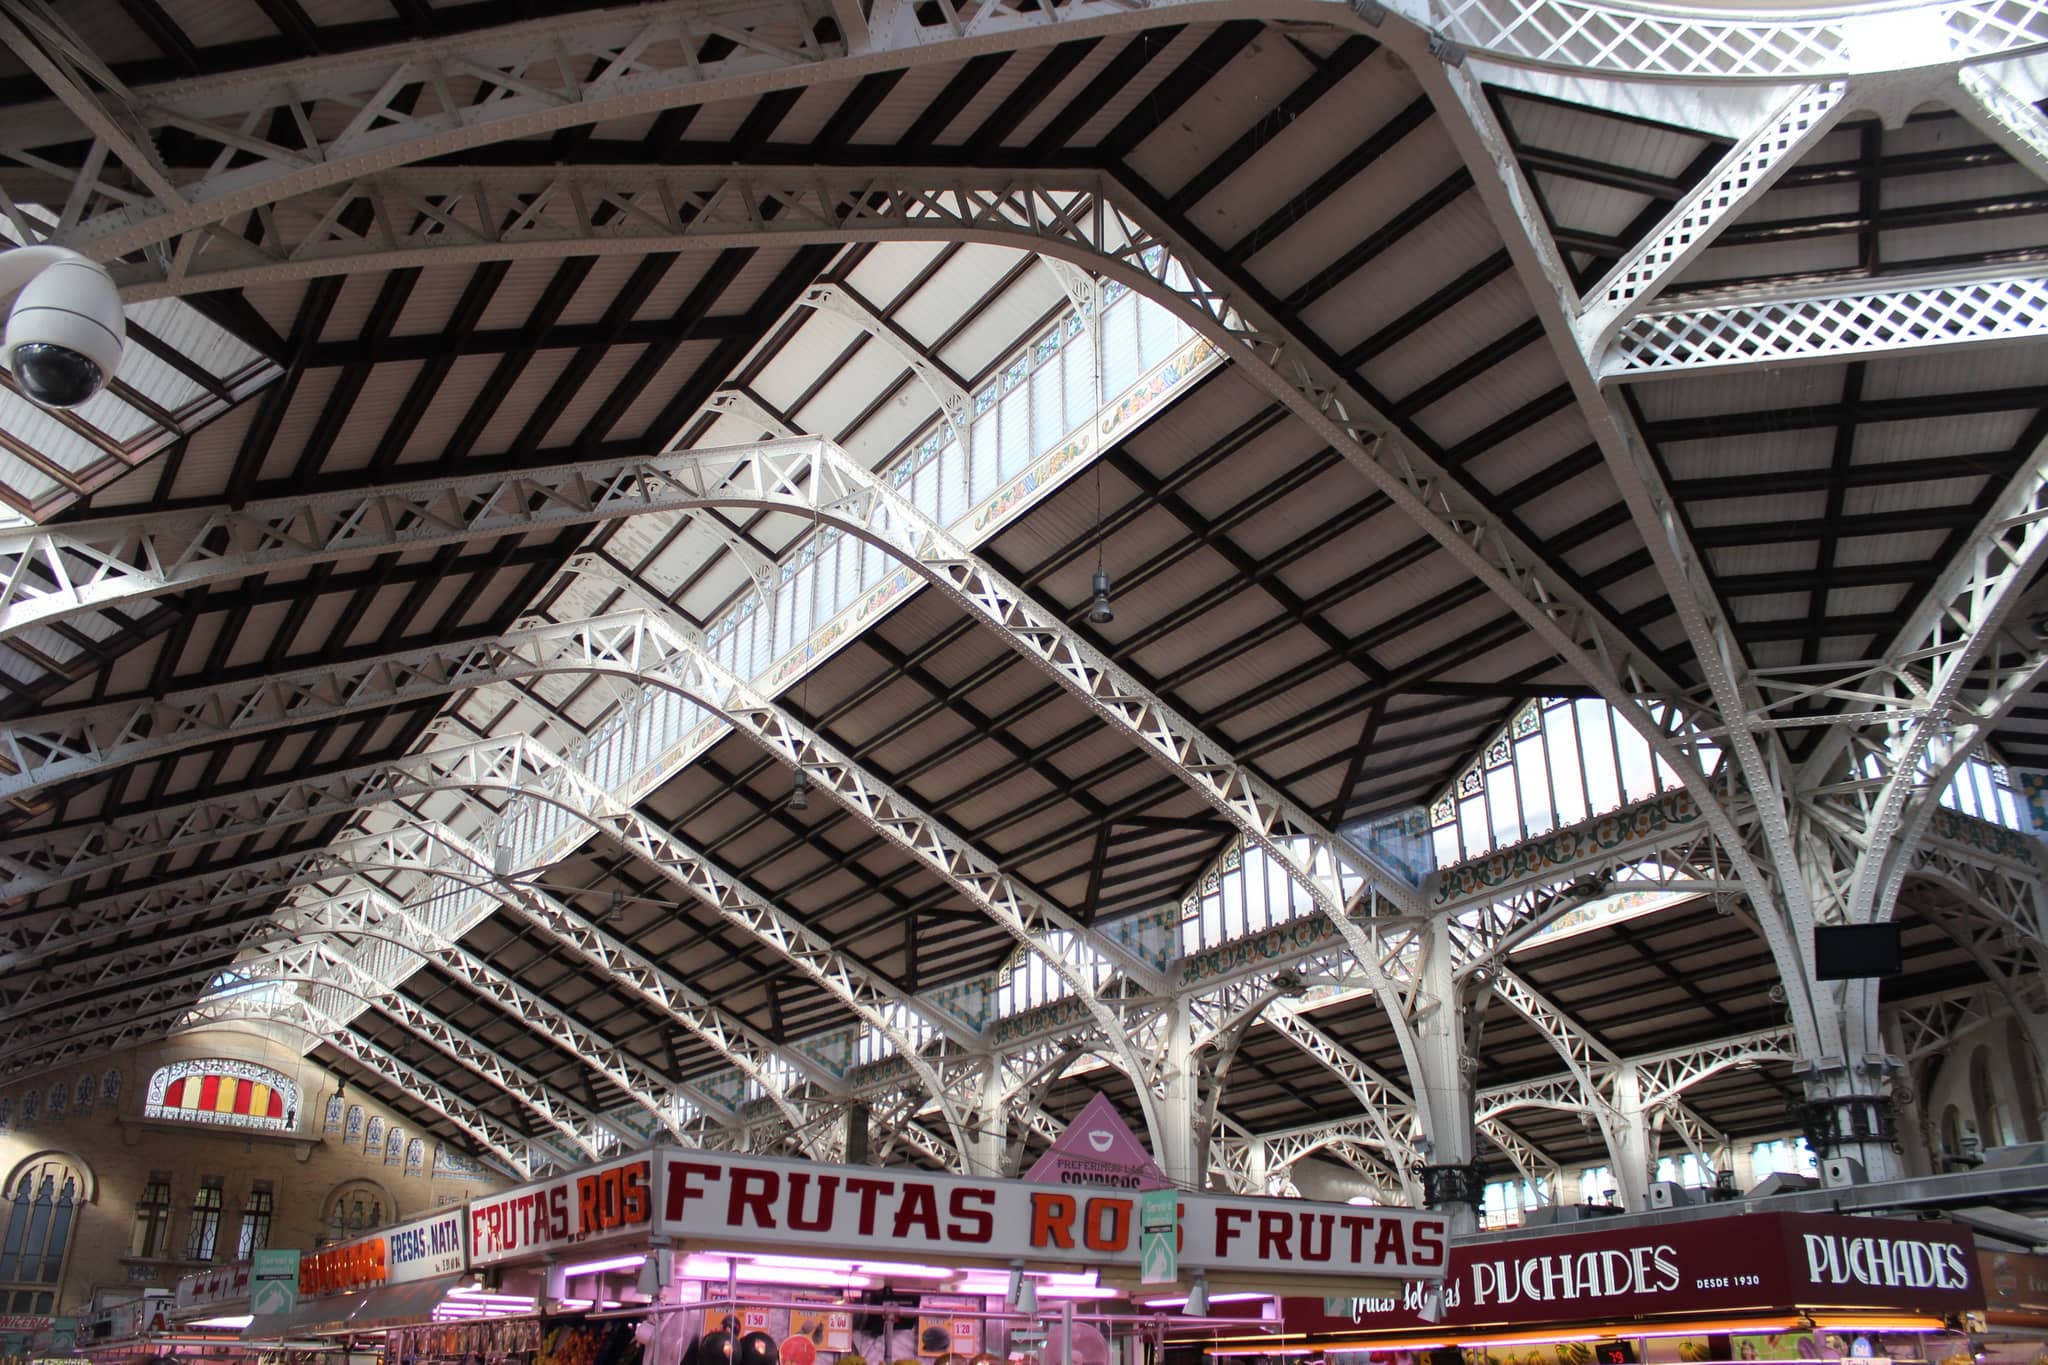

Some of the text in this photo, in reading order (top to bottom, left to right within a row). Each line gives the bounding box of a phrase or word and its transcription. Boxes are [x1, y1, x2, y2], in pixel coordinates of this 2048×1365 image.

[472, 1161, 653, 1257] FRUTAS ROS
[665, 1161, 1185, 1254] FRUTAS RO
[390, 1227, 425, 1265] FRESAS
[430, 1219, 460, 1254] NATA
[1215, 1208, 1445, 1267] FRUTAS
[1803, 1234, 1969, 1289] PUCHADES
[1471, 1245, 1680, 1305] PUCHADES
[1696, 1275, 1760, 1289] DESDE 1930
